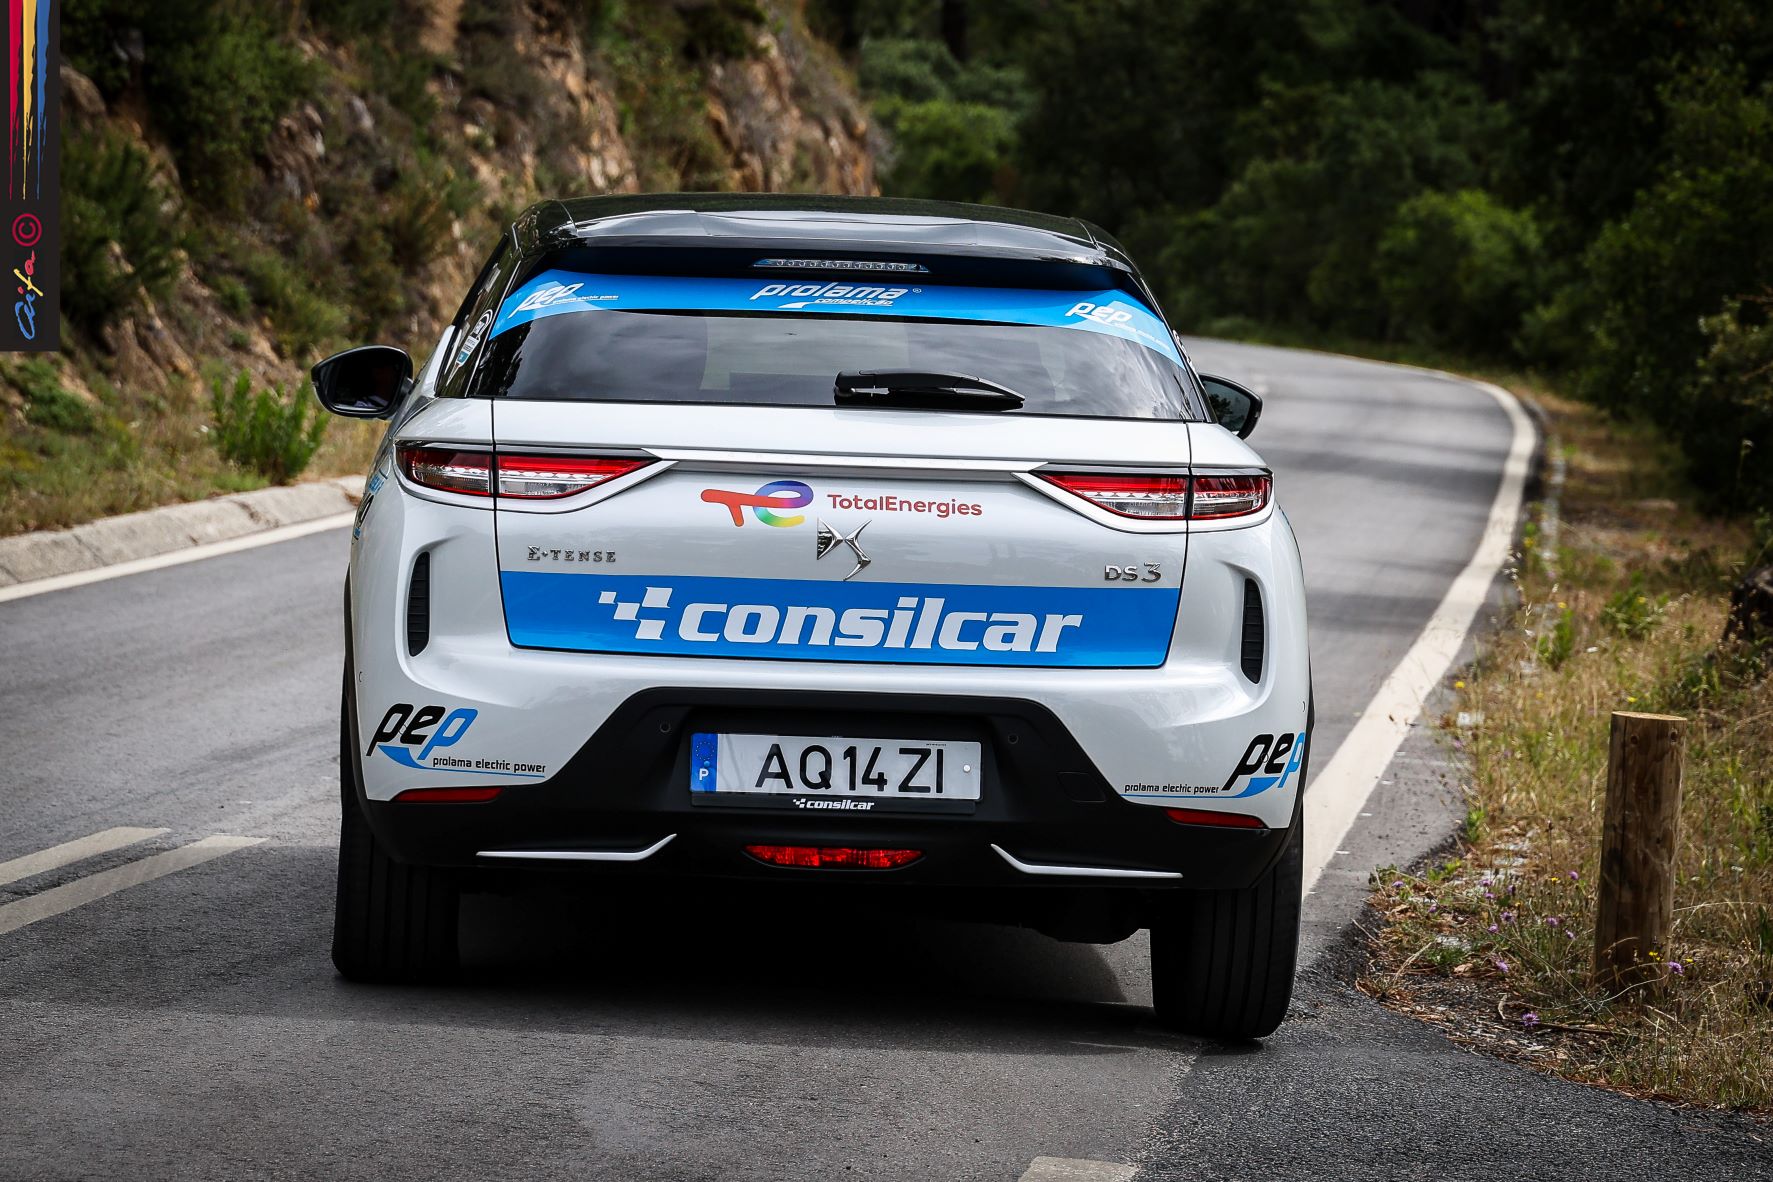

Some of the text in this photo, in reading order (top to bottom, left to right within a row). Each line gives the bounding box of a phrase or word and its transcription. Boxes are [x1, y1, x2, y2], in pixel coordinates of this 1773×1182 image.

[750, 282, 909, 300] prolama
[1065, 302, 1133, 323] pep
[827, 494, 983, 518] TotalEnergies
[678, 597, 1084, 653] consilcar
[366, 703, 479, 760] pep
[432, 756, 547, 774] prolama electric power
[1221, 732, 1305, 791] pep
[698, 768, 709, 781] P
[1124, 783, 1220, 796] prolama electric power
[806, 798, 875, 810] consilcar
